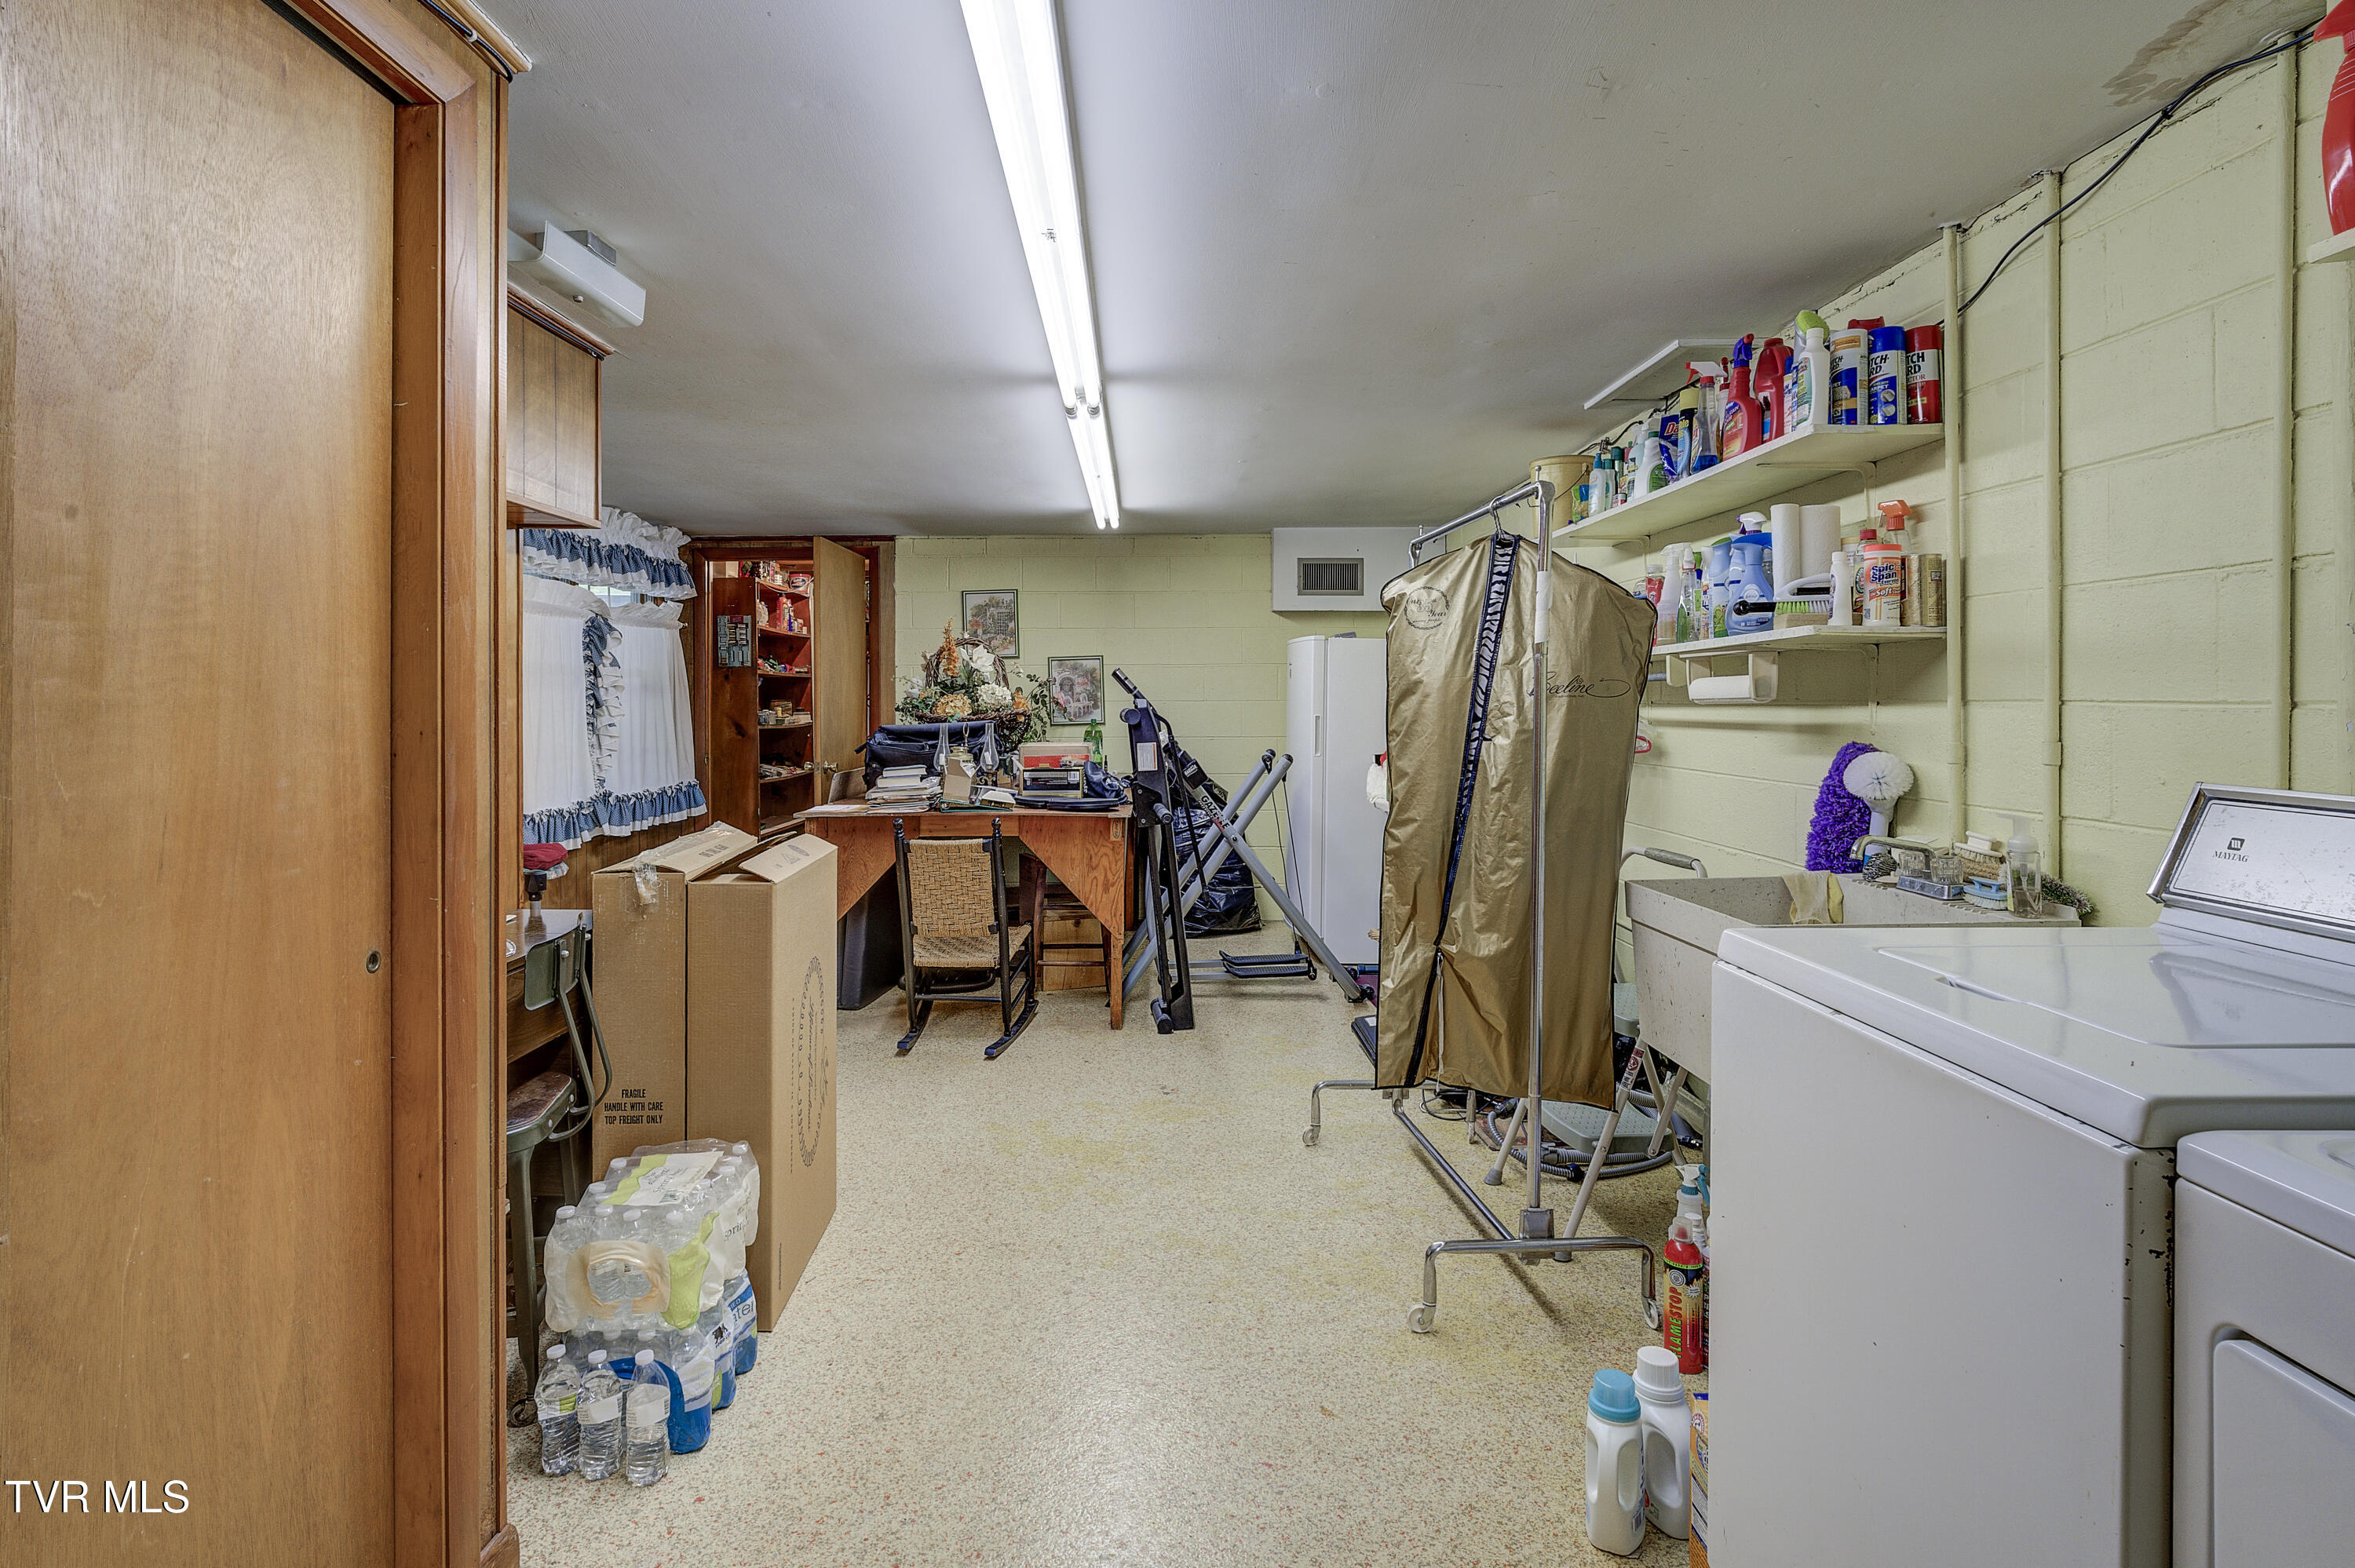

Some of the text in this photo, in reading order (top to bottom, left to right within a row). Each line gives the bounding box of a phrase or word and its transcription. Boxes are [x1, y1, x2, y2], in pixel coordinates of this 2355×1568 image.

[1870, 365, 1882, 376] RD
[1907, 364, 1922, 376] RD
[1664, 422, 1678, 436] Da
[1871, 563, 1895, 574] Spic
[1871, 571, 1897, 582] Span
[2213, 851, 2249, 862] MAYTAG
[622, 1089, 646, 1098] FRAGILE
[604, 1102, 663, 1111] HANDLE WITH CARE
[605, 1115, 663, 1125] TOP FREIGHT ONLY
